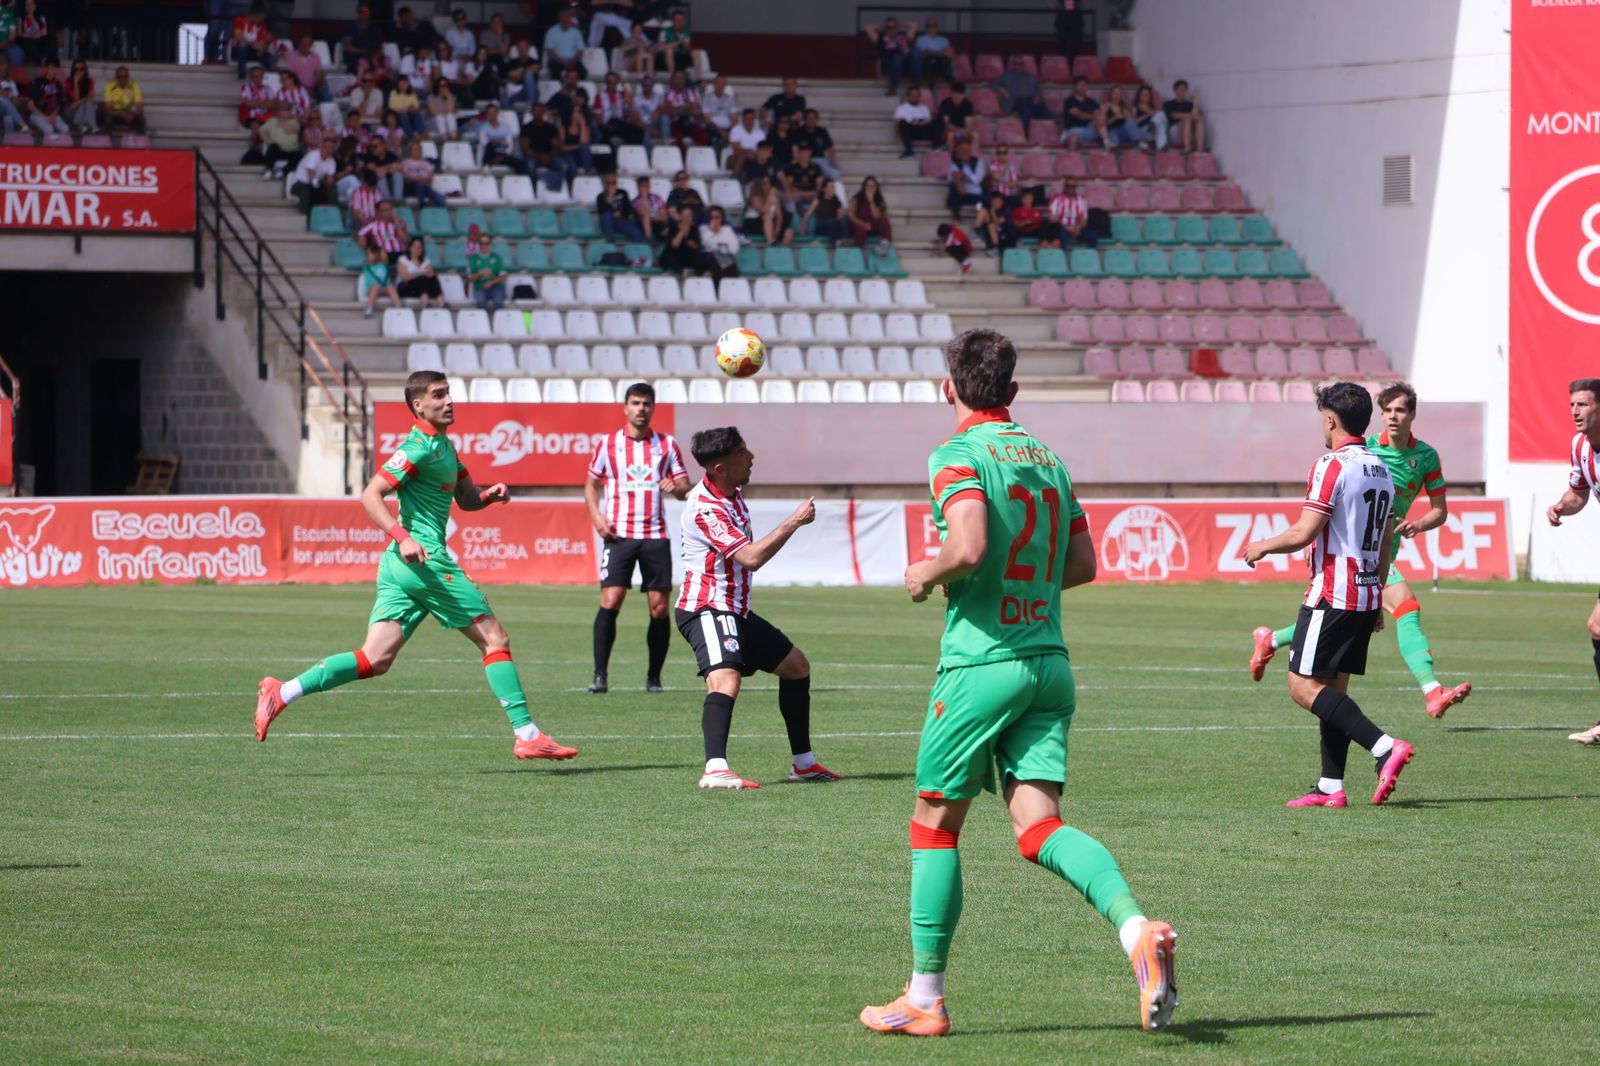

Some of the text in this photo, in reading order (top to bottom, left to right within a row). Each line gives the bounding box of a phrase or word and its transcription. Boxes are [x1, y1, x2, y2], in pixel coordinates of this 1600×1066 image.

[0, 190, 158, 228] MAR, S.A.
[91, 506, 266, 540] Escuela
[1361, 488, 1389, 552] 19
[293, 525, 384, 542] Escucha todos
[462, 526, 501, 543] COPE
[1003, 484, 1060, 583] 21
[293, 547, 313, 564] los
[314, 548, 368, 568] partidos
[463, 543, 528, 560] ZAMORA
[535, 537, 588, 555] COPE.es
[97, 543, 267, 580] infantil
[716, 614, 738, 637] 10
